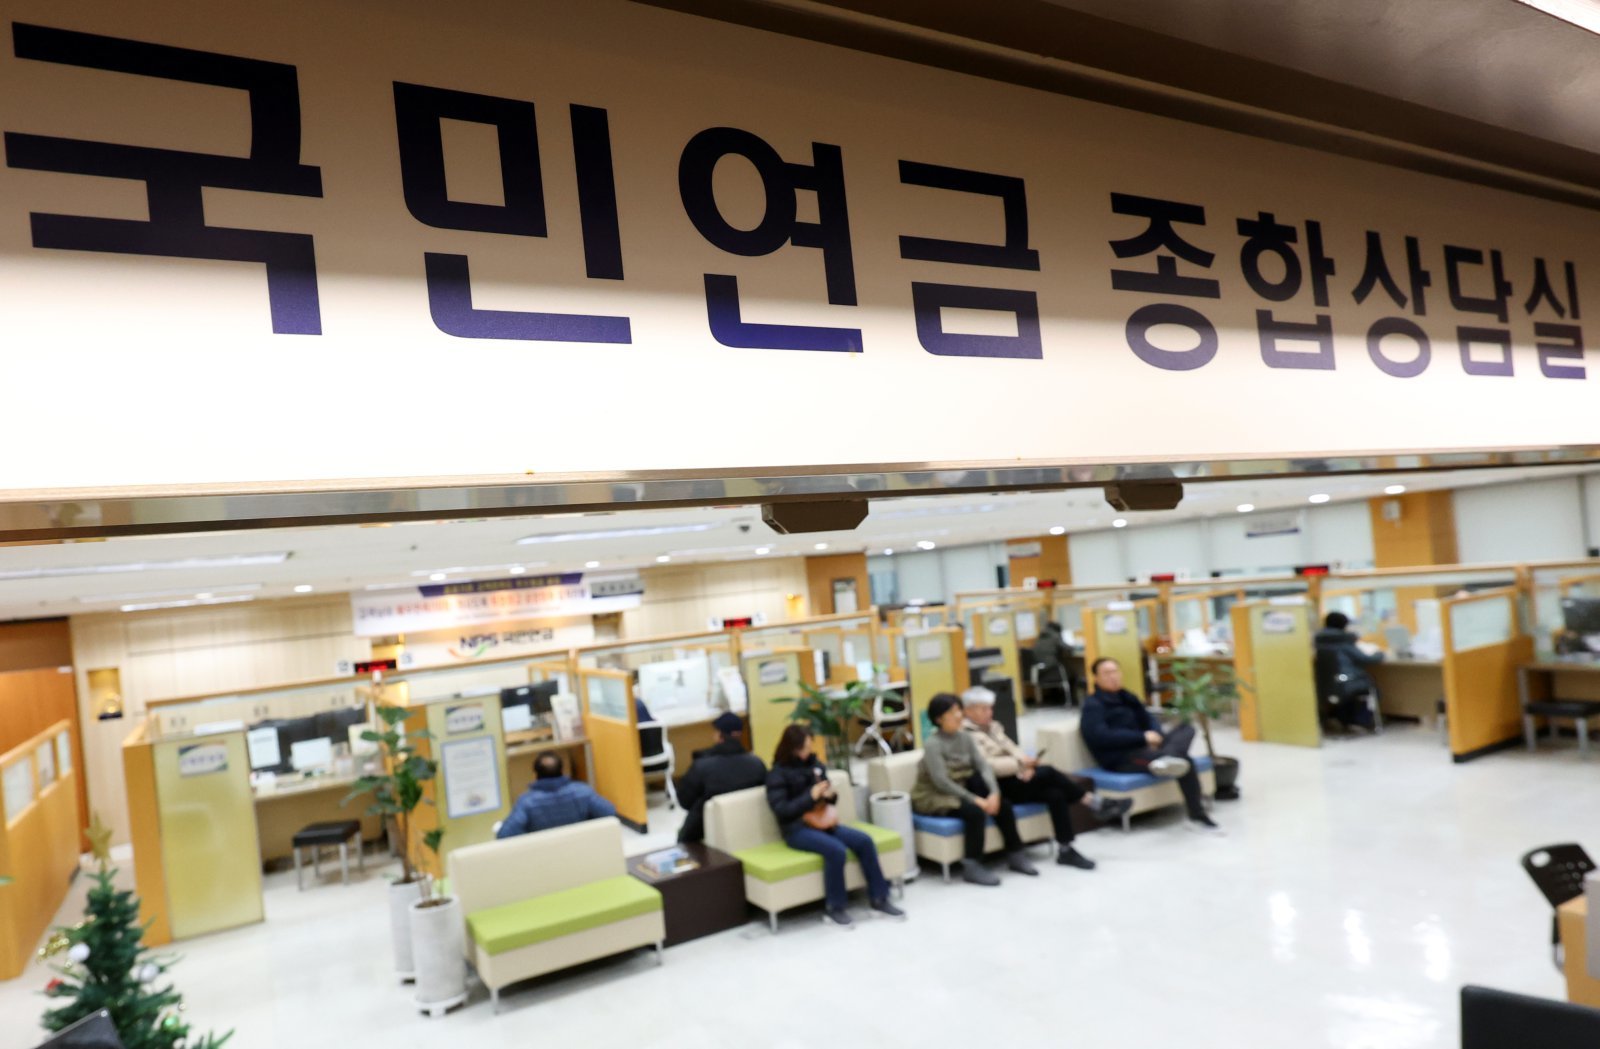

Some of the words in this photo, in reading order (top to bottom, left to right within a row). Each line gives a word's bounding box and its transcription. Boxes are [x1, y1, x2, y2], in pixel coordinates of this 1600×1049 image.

[4, 21, 1044, 360] 국민연금
[1109, 191, 1588, 380] 종합상담실
[460, 632, 499, 650] NPS
